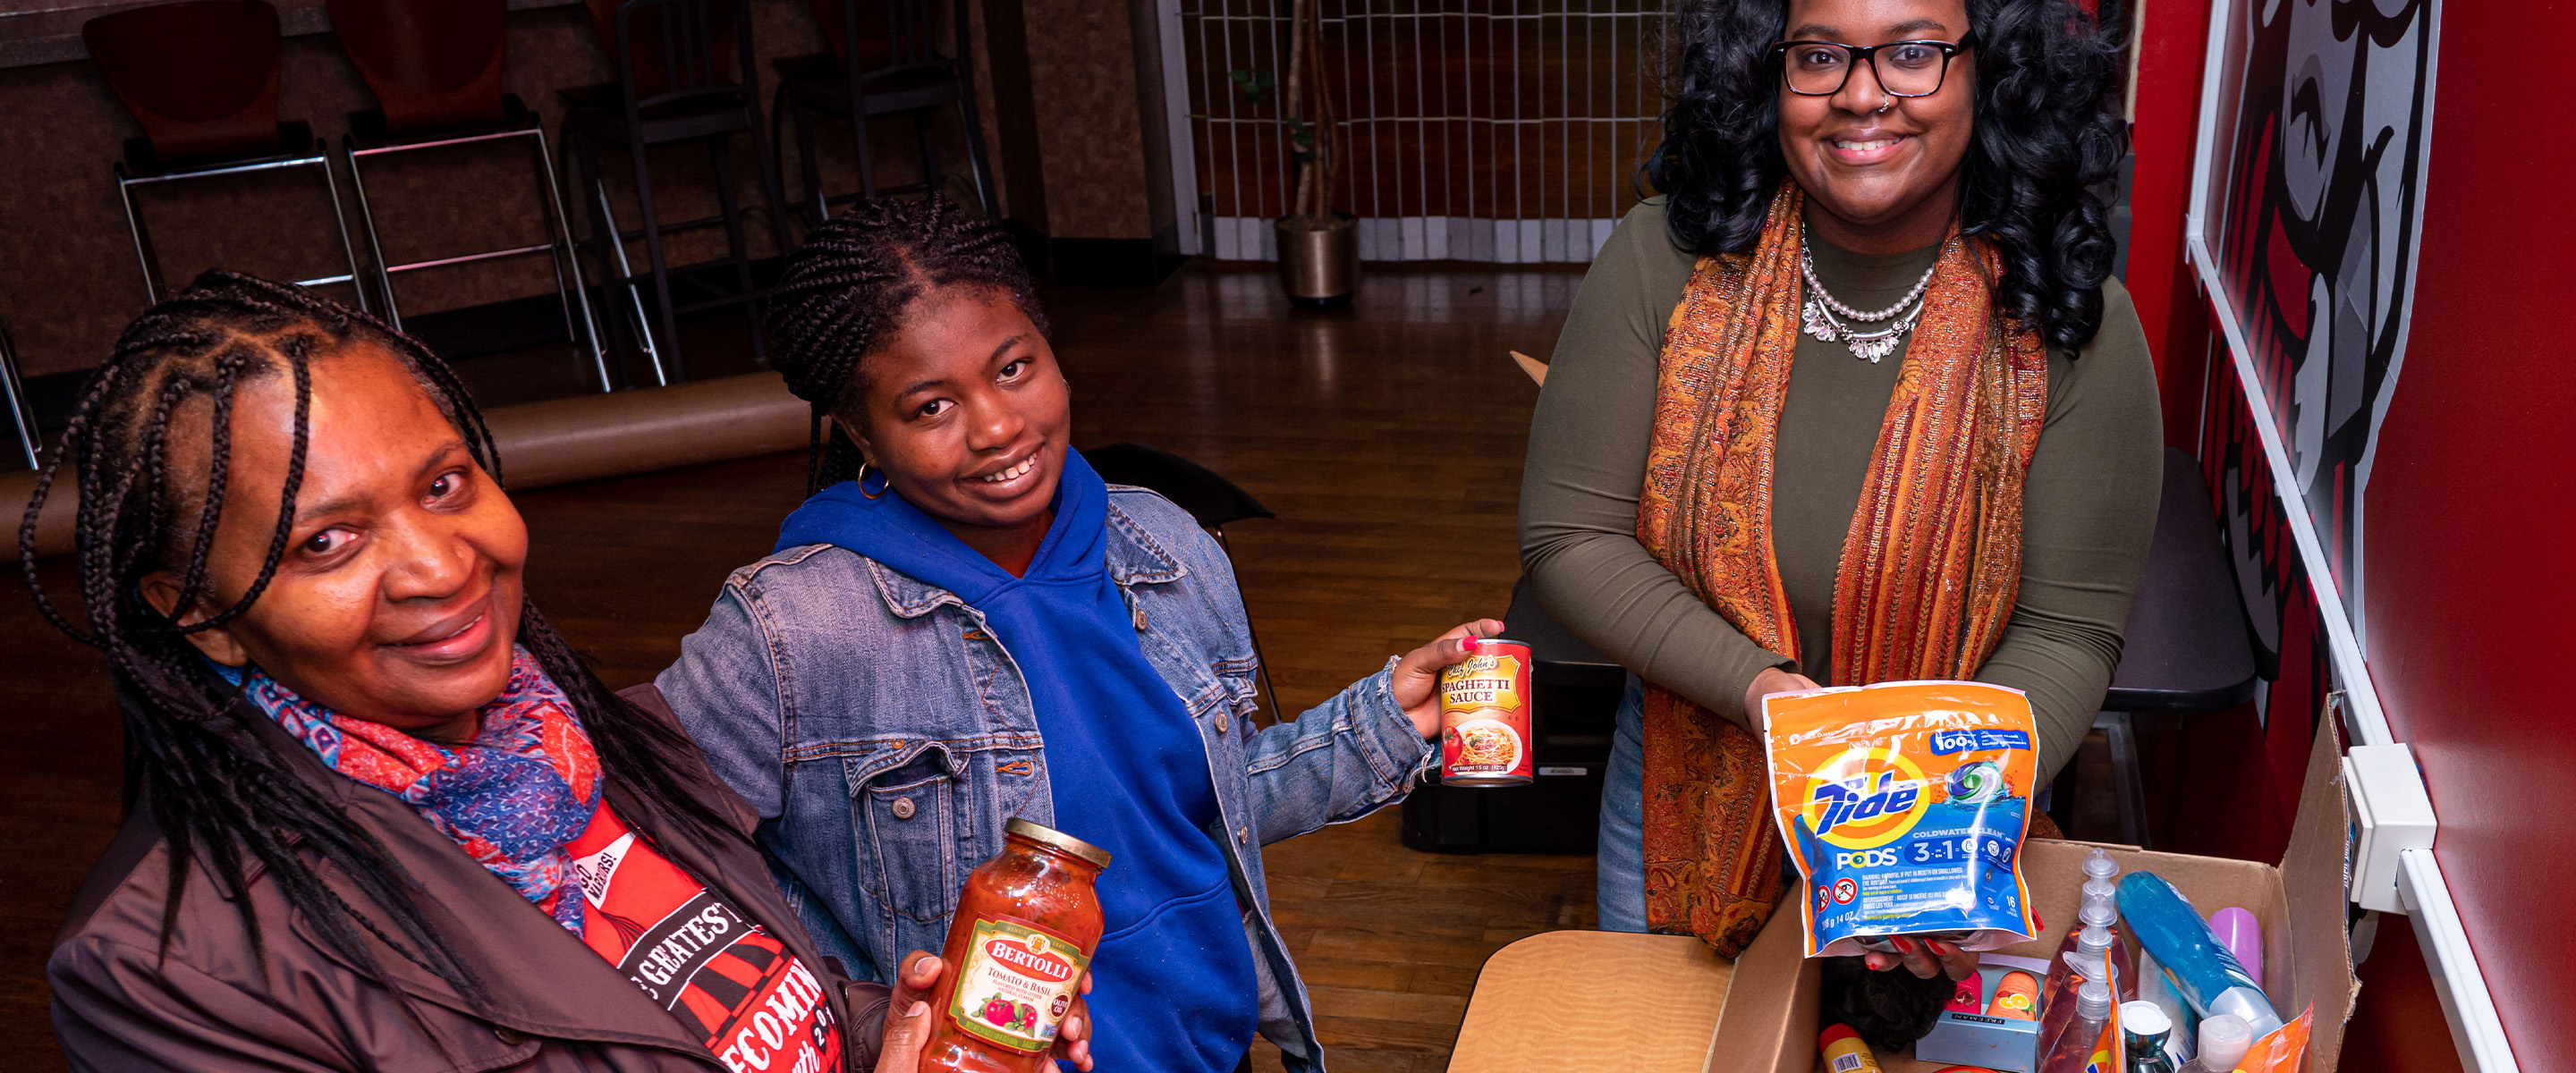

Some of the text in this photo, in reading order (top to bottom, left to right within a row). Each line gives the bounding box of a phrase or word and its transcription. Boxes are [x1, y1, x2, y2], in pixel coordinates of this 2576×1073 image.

[1447, 656, 1496, 677] Chef John's
[1442, 679, 1510, 694] SPAGHETTI
[1449, 691, 1493, 704] SAUCE
[1813, 772, 1919, 837] Tide
[1912, 827, 1973, 839] COLDWATE
[1836, 846, 1898, 870] PODS
[2006, 895, 2016, 908] 16
[1836, 914, 1843, 924] 14
[1844, 910, 1855, 921] OZ
[990, 941, 1069, 979] BERTOLLI
[987, 967, 1021, 985] TOMATO
[1030, 982, 1052, 997] BASIL
[992, 980, 1015, 992] FLAVORED
[1019, 993, 1035, 1002] FLAVOR
